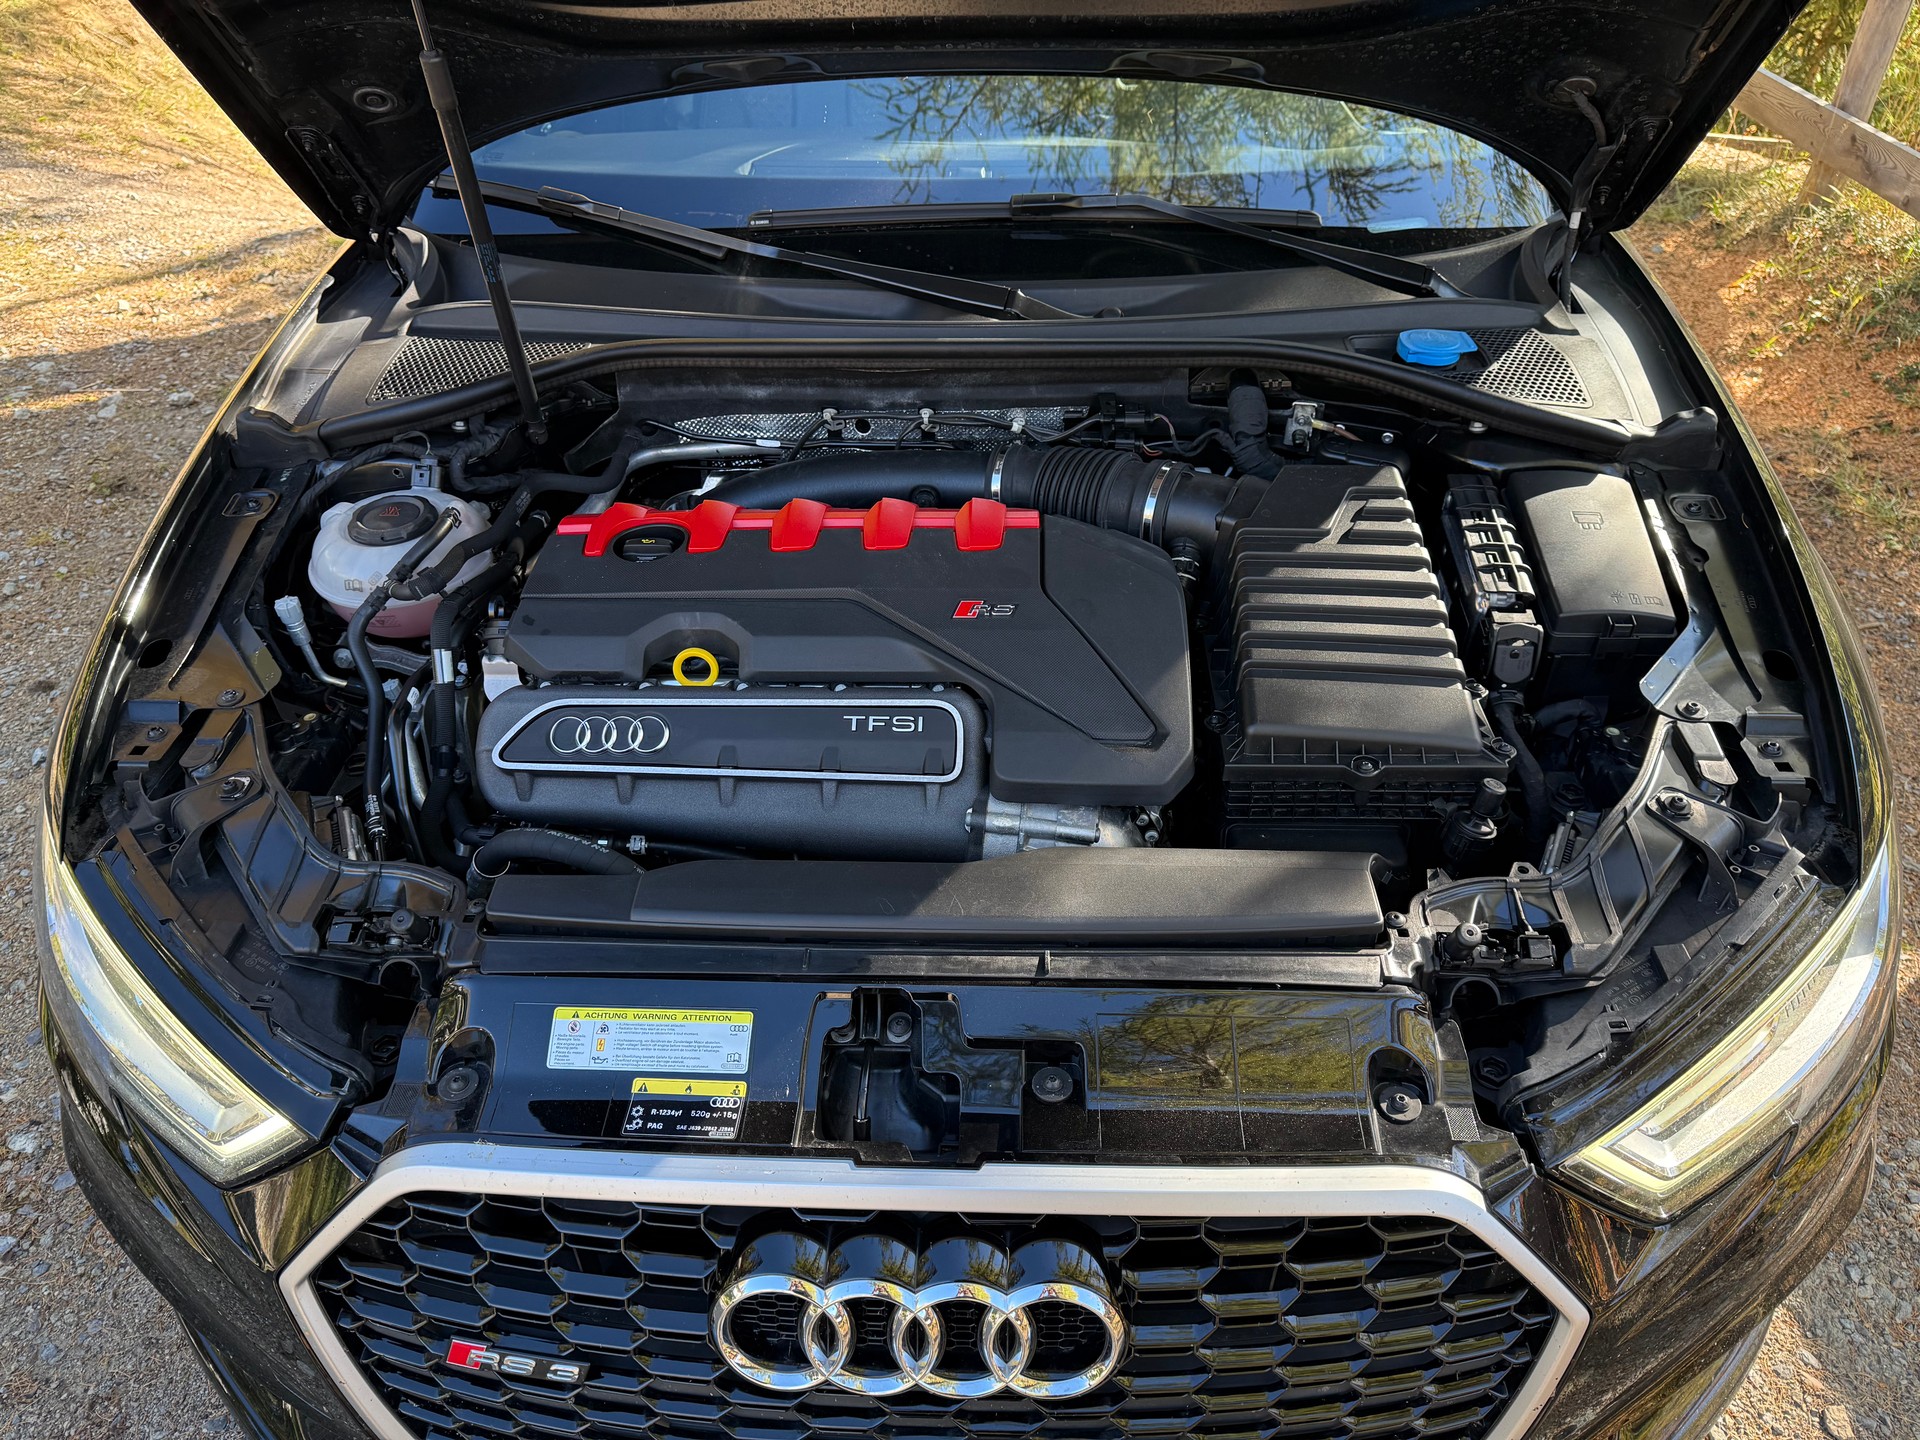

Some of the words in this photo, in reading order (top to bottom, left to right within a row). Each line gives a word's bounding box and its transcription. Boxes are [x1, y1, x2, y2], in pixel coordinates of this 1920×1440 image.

[963, 602, 1015, 617] RS
[843, 716, 924, 732] TFSI
[651, 1108, 682, 1117] R-1234yf
[466, 1349, 536, 1376] RS
[546, 1363, 580, 1383] 3
